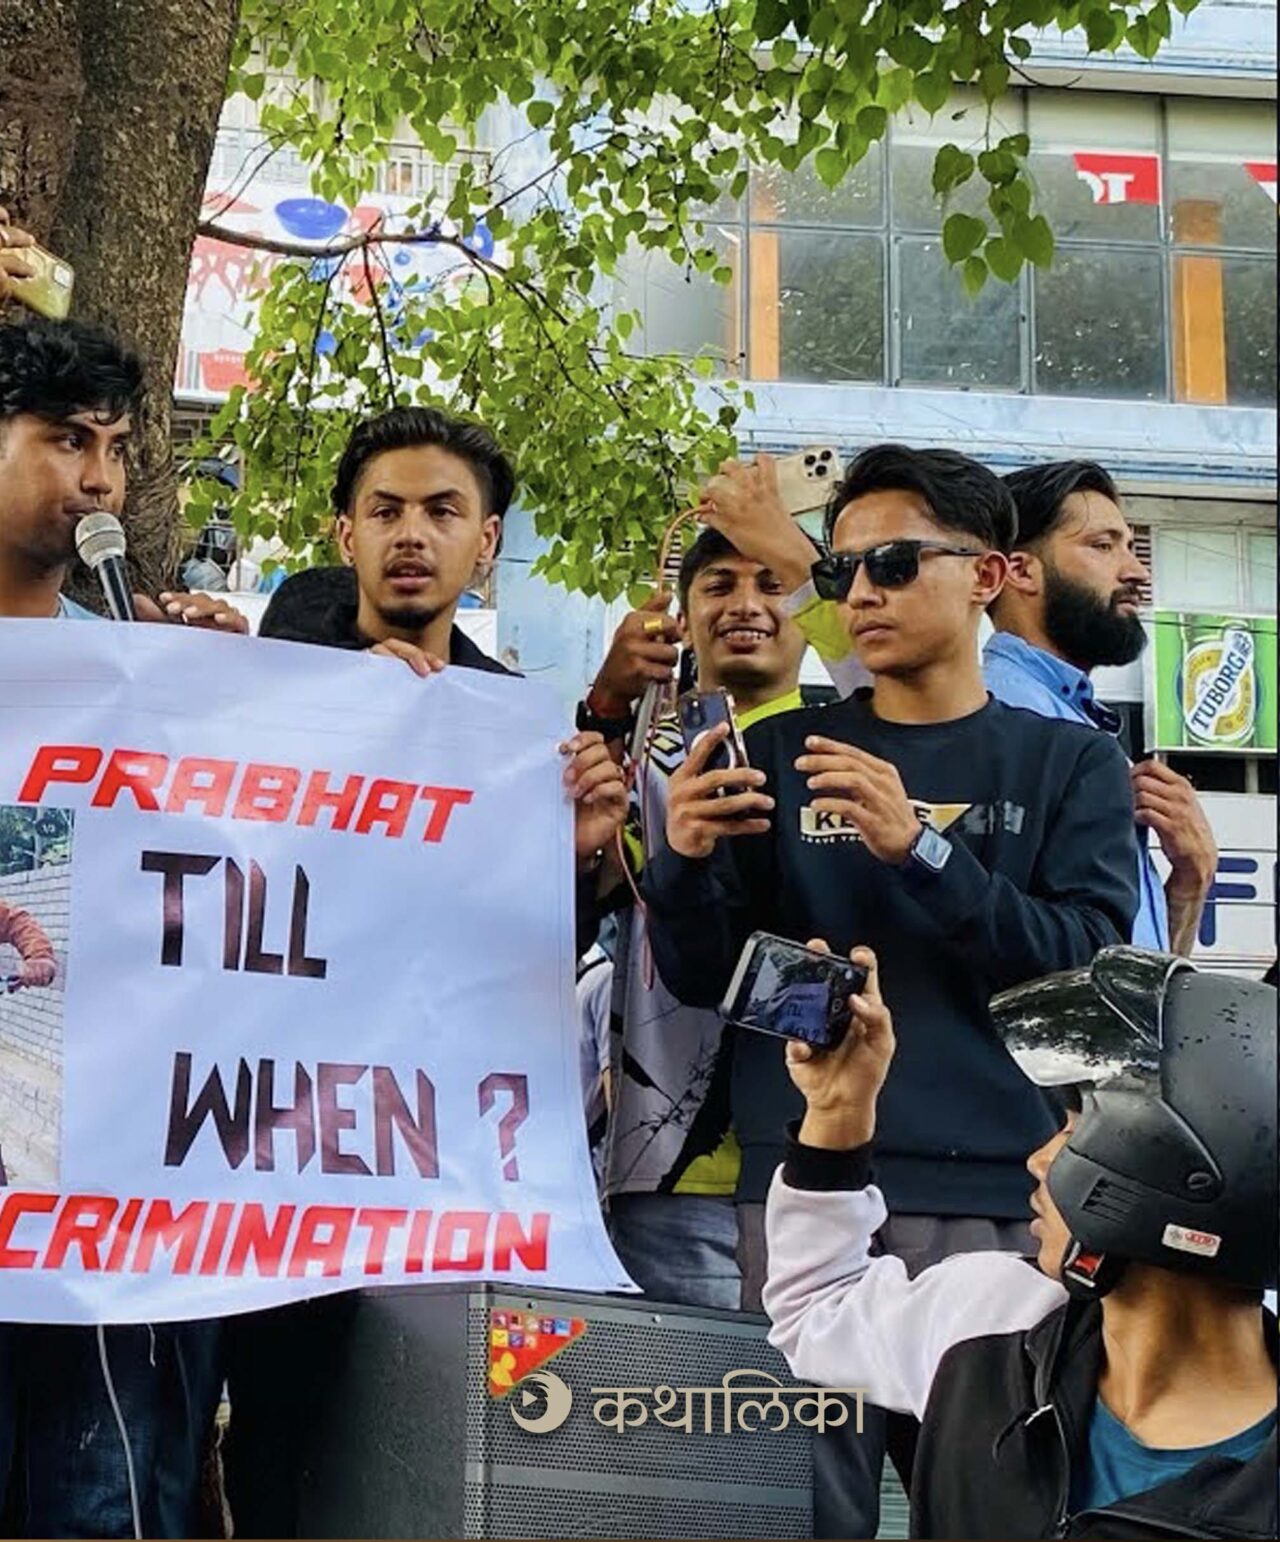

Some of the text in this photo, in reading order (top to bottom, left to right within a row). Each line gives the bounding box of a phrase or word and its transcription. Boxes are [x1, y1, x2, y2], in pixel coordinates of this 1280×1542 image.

[1191, 651, 1246, 730] TUBORG
[17, 743, 474, 844] PRABHAT
[140, 850, 329, 979] TILL
[163, 1051, 531, 1183] WHEN ?
